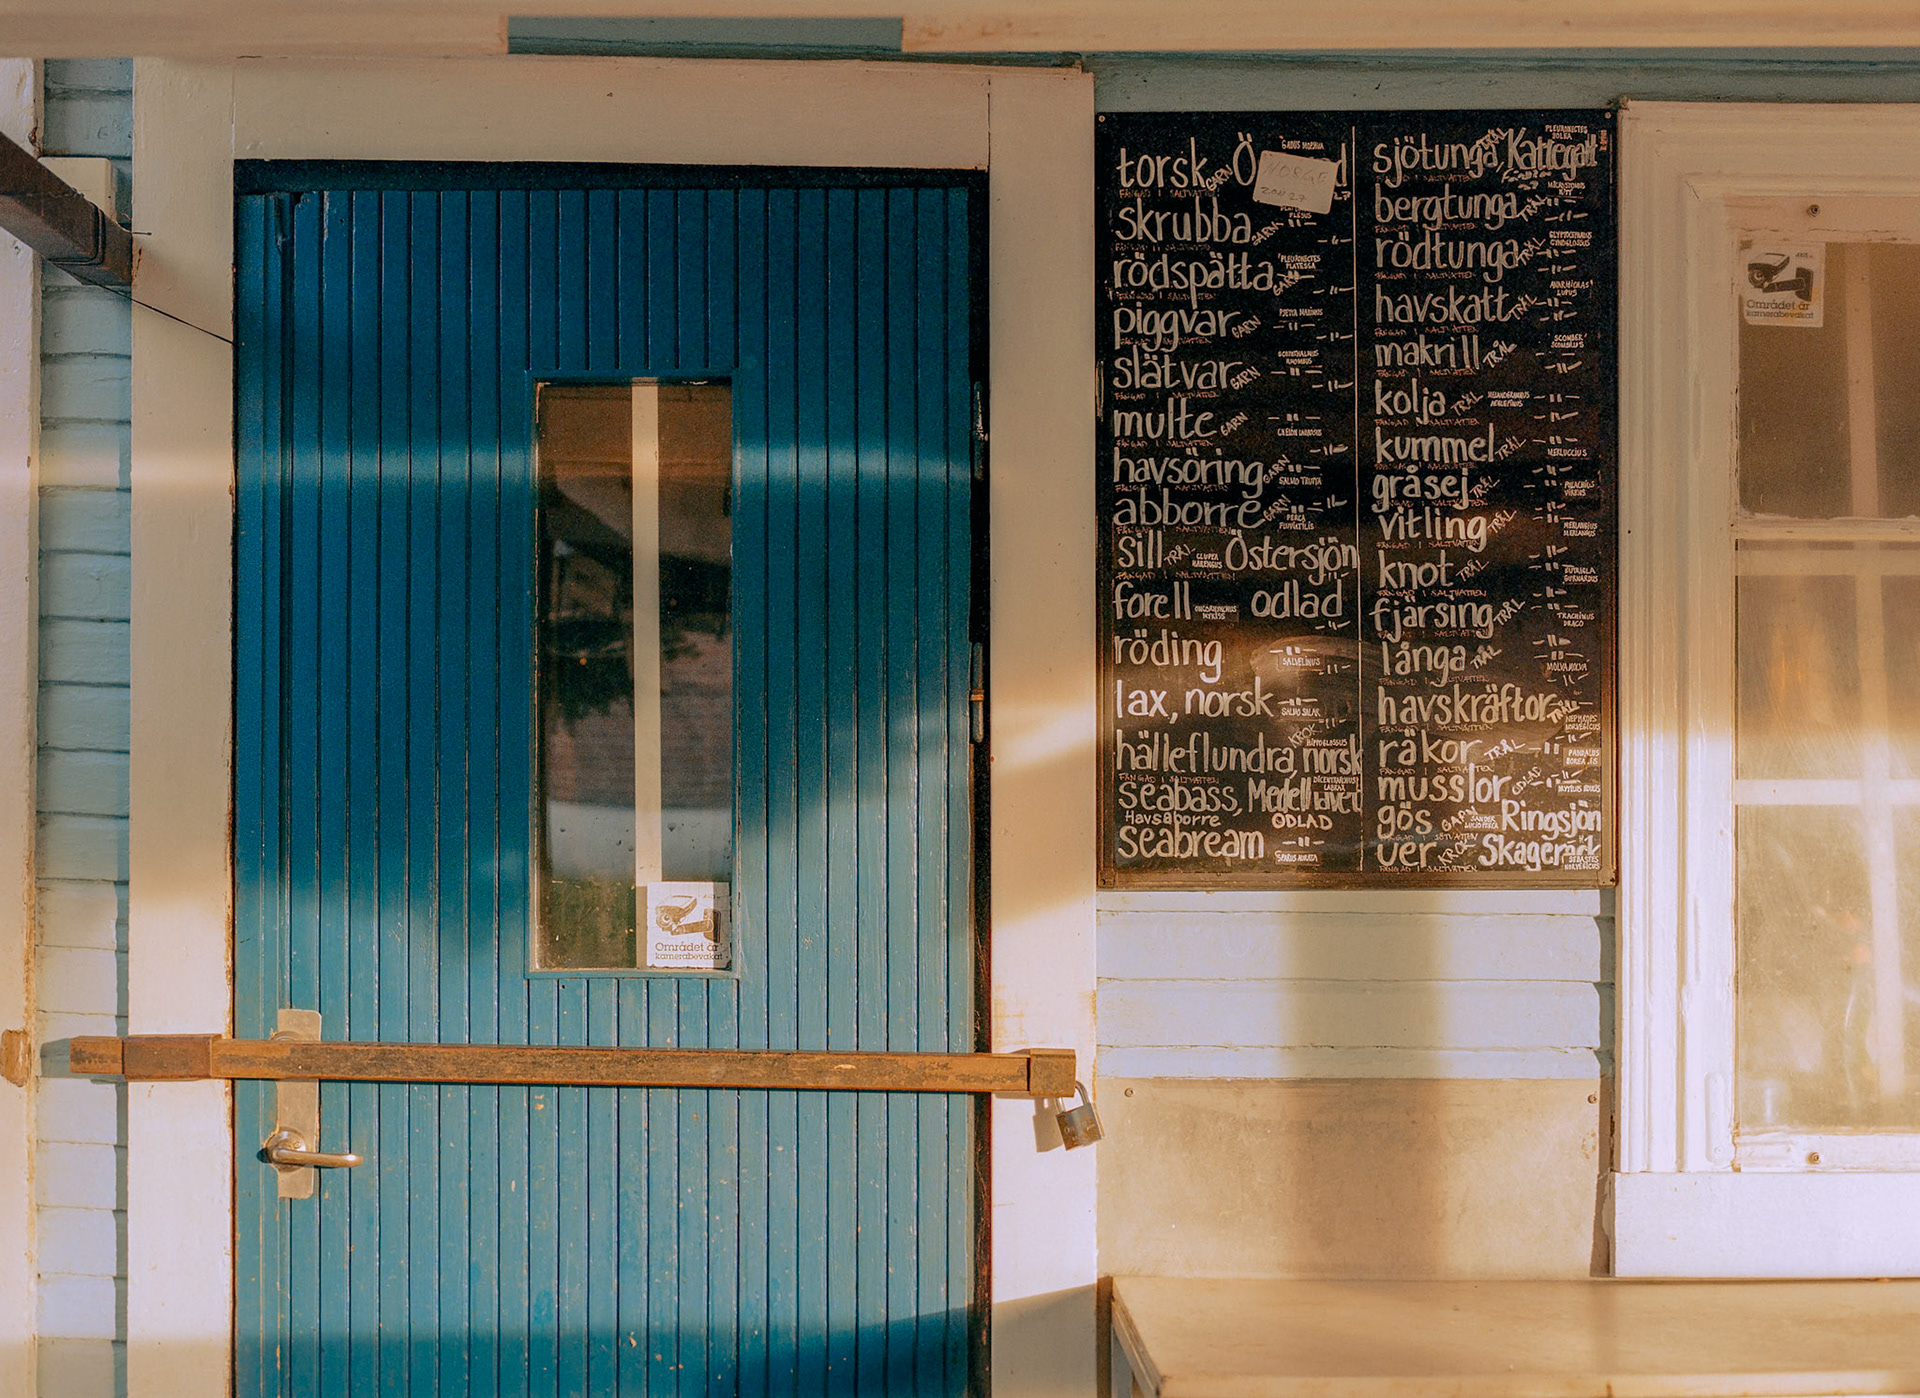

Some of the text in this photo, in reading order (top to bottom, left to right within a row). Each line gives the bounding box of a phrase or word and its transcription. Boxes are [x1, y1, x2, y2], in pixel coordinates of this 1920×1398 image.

[1116, 136, 1207, 188] torsk
[1205, 164, 1234, 191] GARN
[1116, 192, 1251, 243] skrubba
[1375, 183, 1518, 231] bergtunga
[1376, 230, 1518, 283] rödtunga
[1114, 252, 1273, 309] rödspätta
[1376, 283, 1510, 323] havskatt
[1746, 310, 1813, 318] kamerabevakat
[1747, 300, 1795, 310] Området
[1114, 302, 1240, 352] piggvar
[1231, 315, 1261, 339] GARN
[1113, 345, 1243, 389] slätvar
[1375, 334, 1479, 369] makrill
[1483, 340, 1518, 368] TRÅL
[1230, 366, 1261, 390] GARN
[1114, 398, 1217, 439] multe
[1375, 378, 1445, 425] kolja
[1451, 392, 1483, 416] TRÅL
[1220, 412, 1249, 436] GARN
[1376, 422, 1494, 463] kummel
[1495, 436, 1527, 460] TRÅL
[1113, 447, 1263, 498] havsöring
[1372, 465, 1468, 513] gråsej
[1113, 487, 1265, 529] abborre
[1487, 510, 1517, 534] TRÅL
[1379, 505, 1487, 552] vitling
[1226, 529, 1357, 586] Östersjön
[1379, 550, 1453, 589] knot
[1456, 559, 1489, 582] TRÅL
[1113, 579, 1342, 620] forell odlad
[1494, 599, 1525, 626] TRÅL
[1369, 597, 1494, 643] fjärsing
[1115, 629, 1222, 683] röding
[1382, 641, 1465, 687] långa
[1116, 677, 1274, 724] lax, norsk
[1378, 683, 1557, 724] havskräftor
[1288, 723, 1322, 748] KROK
[1303, 734, 1362, 774] norsk
[1379, 729, 1482, 767] räkor
[1484, 738, 1526, 761] TRÅL
[1378, 762, 1512, 803] musslor
[1272, 813, 1333, 830] ODLAD
[1377, 800, 1600, 840] gös Ringsjön
[1442, 805, 1477, 831] GARN
[1377, 841, 1437, 868] uer
[655, 941, 704, 951] Området
